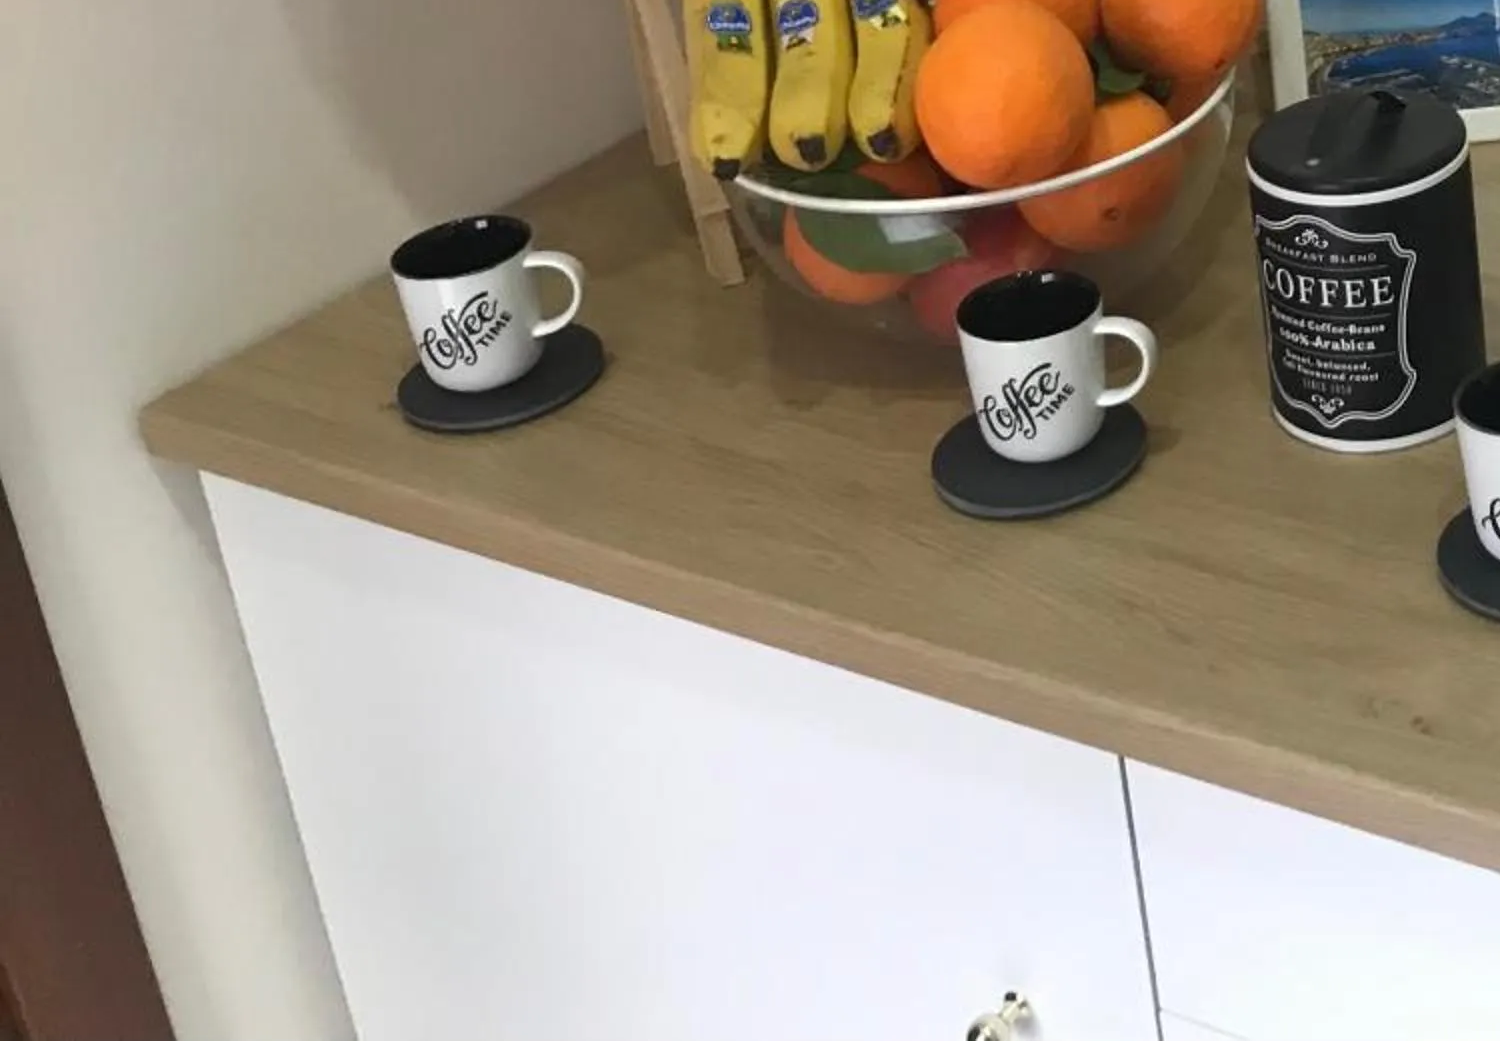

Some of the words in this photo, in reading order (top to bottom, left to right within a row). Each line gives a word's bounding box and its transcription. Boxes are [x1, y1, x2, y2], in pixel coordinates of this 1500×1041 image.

[1263, 258, 1395, 308] COFFEE
[419, 291, 499, 370] Coffee
[475, 310, 513, 348] TIME
[979, 362, 1060, 441] Coffee
[1035, 382, 1075, 421] TIME
